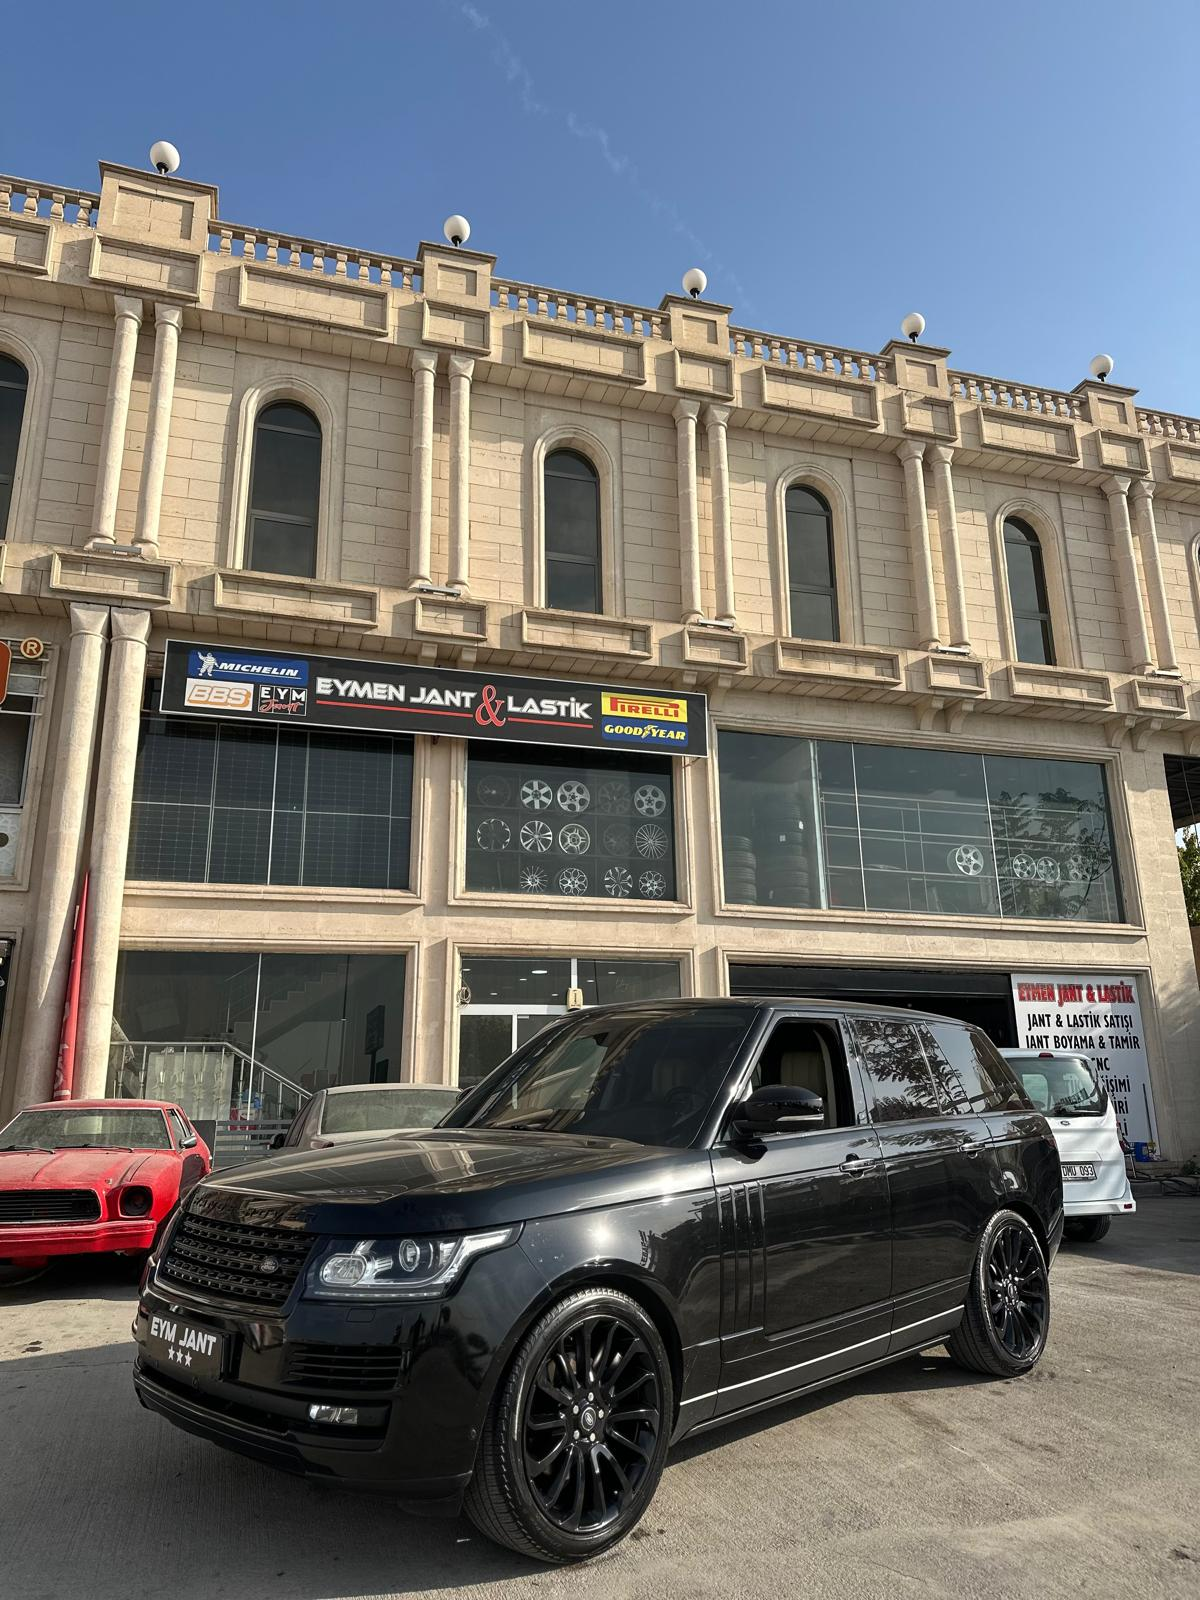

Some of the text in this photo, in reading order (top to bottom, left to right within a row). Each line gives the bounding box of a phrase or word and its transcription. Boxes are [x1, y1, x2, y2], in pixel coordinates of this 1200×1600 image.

[219, 662, 299, 677] MICHELIN
[188, 685, 251, 708] BBS
[261, 687, 306, 701] EYM
[316, 677, 592, 727] EYMEN JANT & LASTİK
[610, 697, 680, 717] PIRELLI
[1017, 980, 1135, 1007] EYMEN JANT & LASTİK
[1028, 1011, 1133, 1032] JANT & LASTİK SATIŞI
[1053, 1035, 1095, 1049] BOYAMA
[1099, 1035, 1106, 1049] &
[1108, 1032, 1140, 1049] TAMİR
[1080, 1165, 1094, 1177] 093
[150, 1316, 217, 1356] EYM JANT
